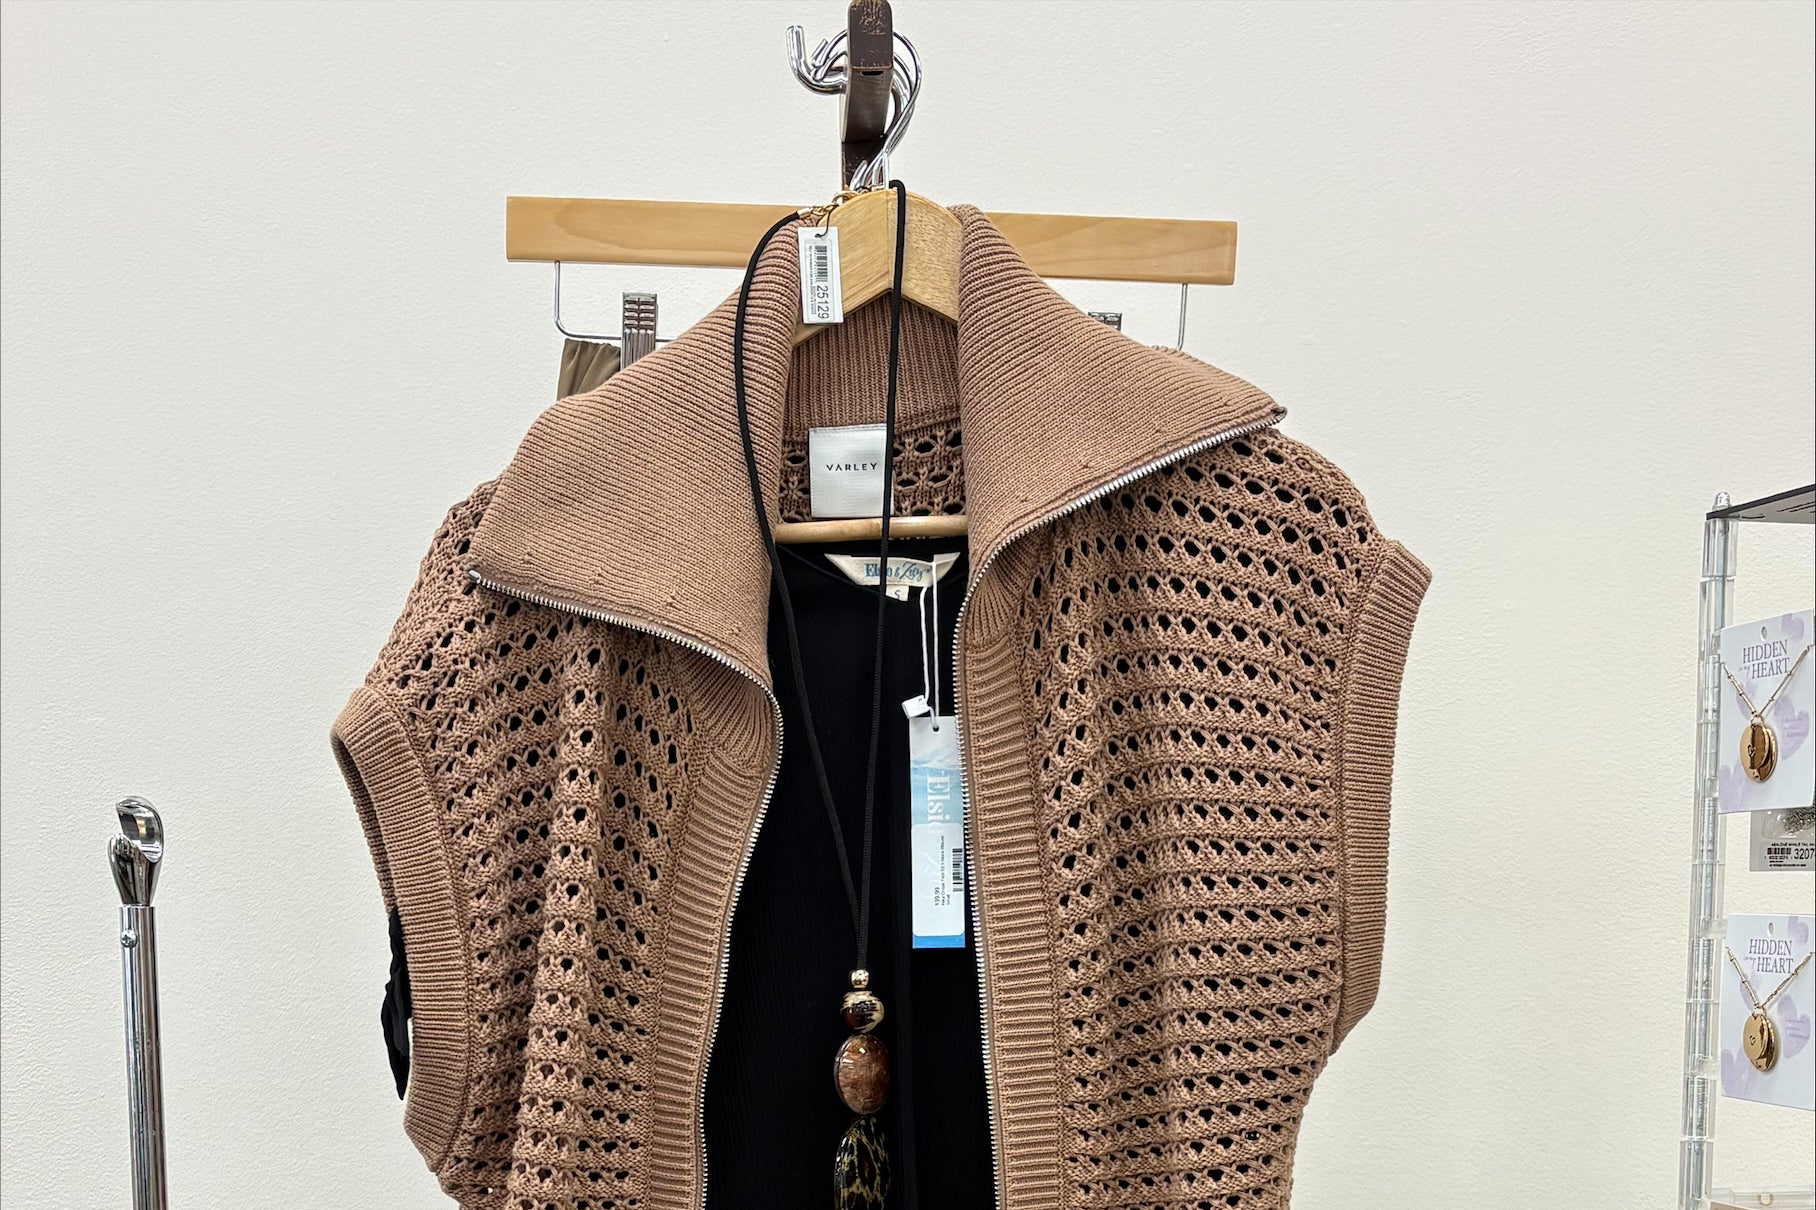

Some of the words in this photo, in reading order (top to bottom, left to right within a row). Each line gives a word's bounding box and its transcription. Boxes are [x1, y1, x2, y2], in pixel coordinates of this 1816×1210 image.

[816, 285, 830, 320] 25129
[826, 462, 878, 472] VARLEY
[1742, 639, 1789, 664] HIDDEN
[1751, 657, 1790, 680] HEART
[926, 774, 951, 823] Elsi
[1748, 938, 1793, 956] HIDDEN
[1756, 956, 1794, 974] HEART
